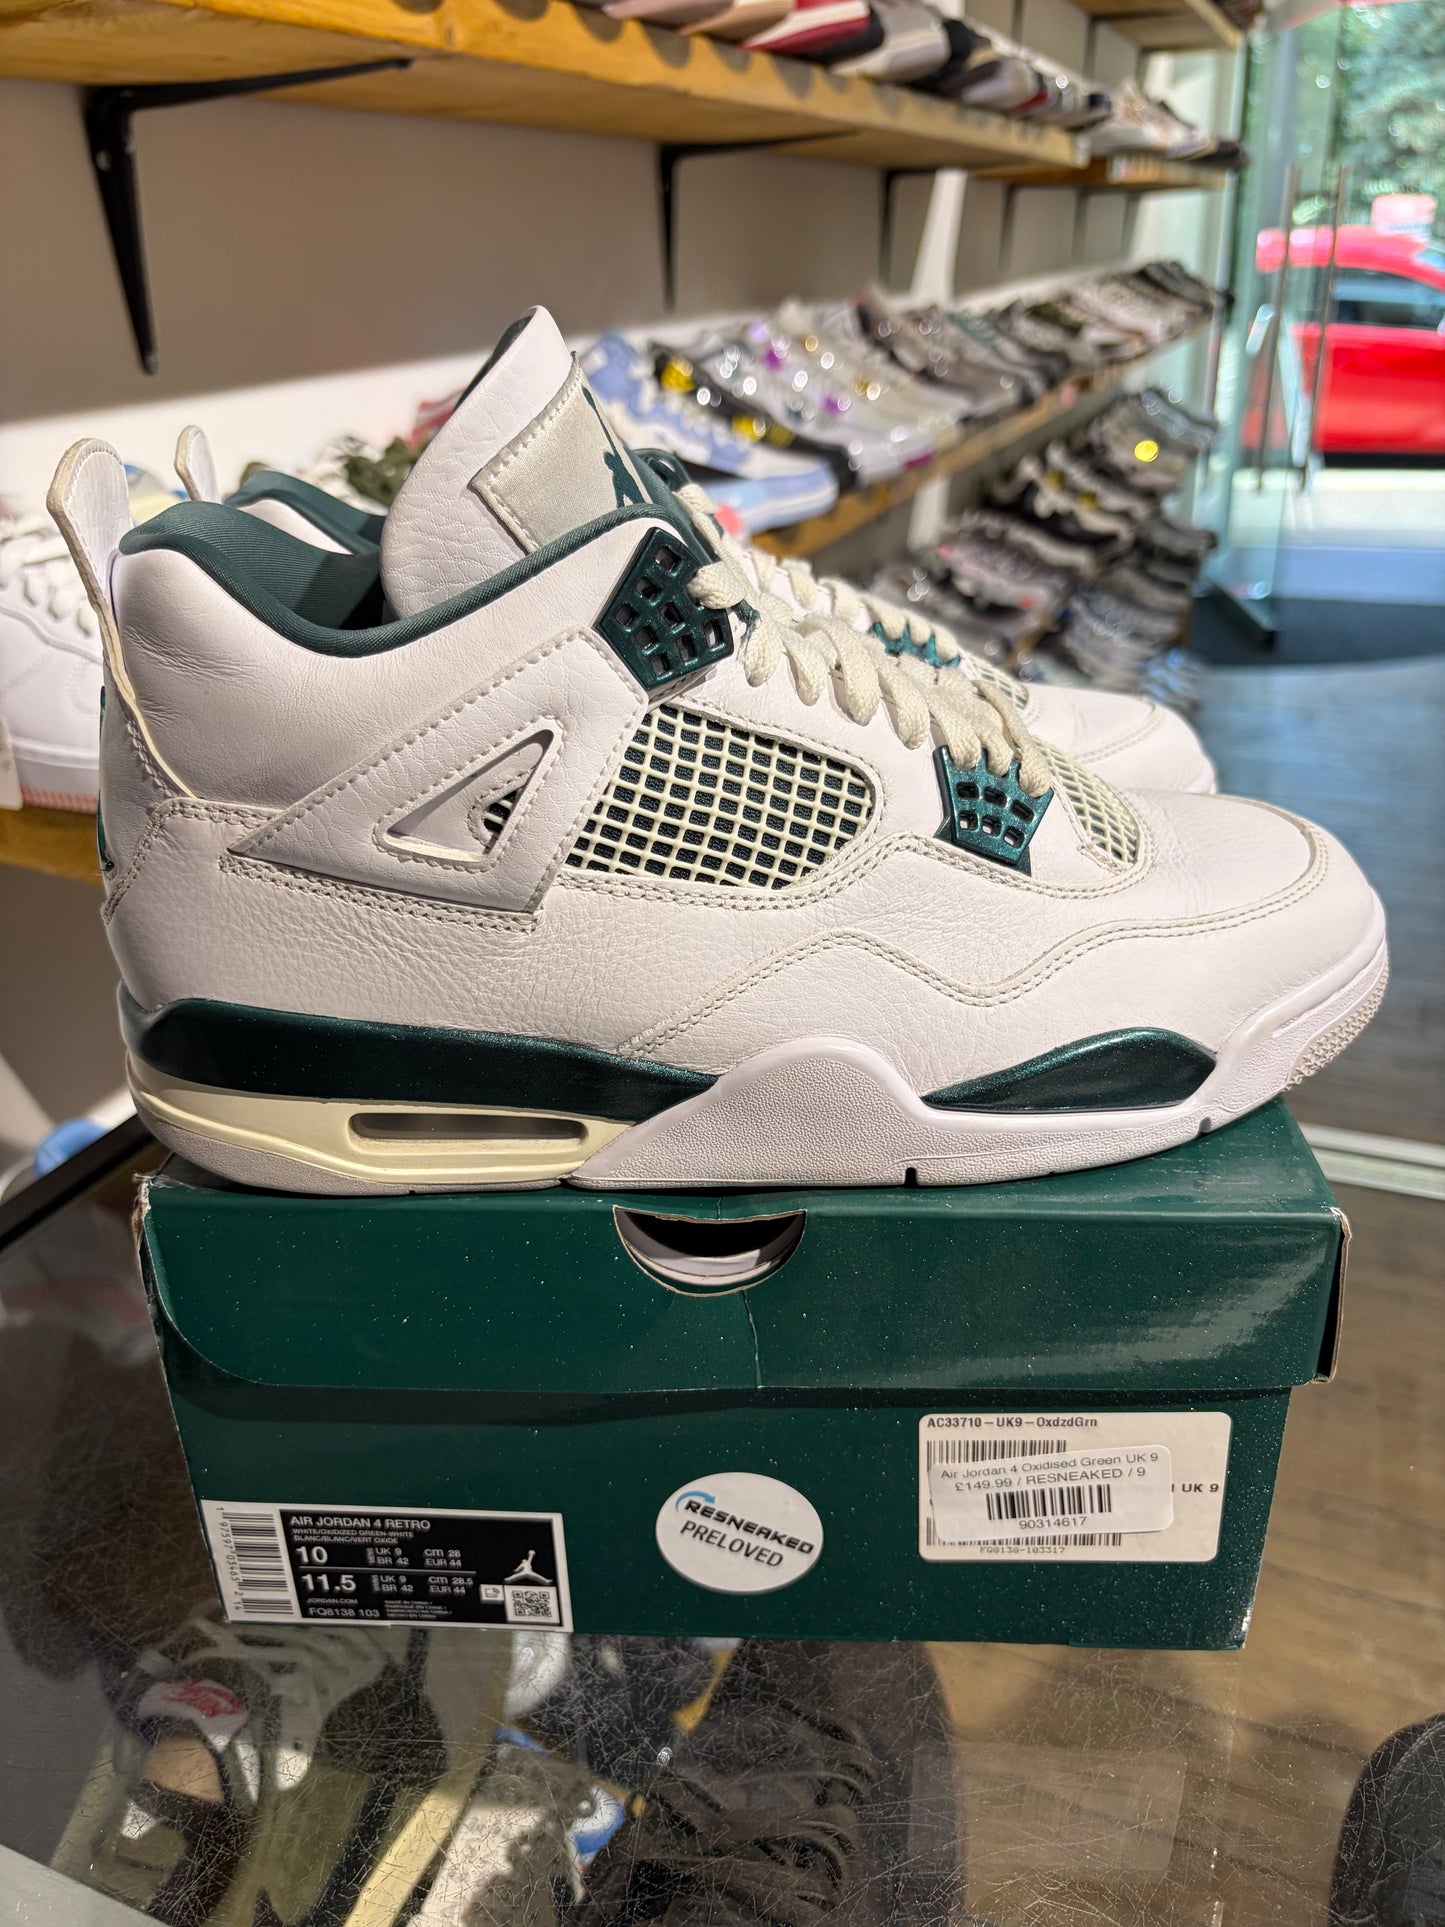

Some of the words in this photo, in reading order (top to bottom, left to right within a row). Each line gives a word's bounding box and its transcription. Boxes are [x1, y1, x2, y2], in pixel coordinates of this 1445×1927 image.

[941, 1470, 957, 1479] Air
[962, 1467, 1006, 1479] Jordan
[1010, 1465, 1017, 1473] 4
[1021, 1459, 1077, 1473] Oxidised
[1080, 1455, 1121, 1467] Green
[1126, 1453, 1146, 1463] UK
[1150, 1452, 1159, 1462] 9
[954, 1478, 1012, 1492] £149.99
[1025, 1468, 1123, 1486] RESNEAKED
[1136, 1466, 1146, 1477] 9
[1181, 1483, 1204, 1493] UK
[1209, 1483, 1219, 1493] 9
[290, 1516, 314, 1526] AIR
[316, 1517, 371, 1528] JORDAN
[373, 1519, 382, 1527] 4
[385, 1519, 431, 1530] RETRO
[684, 1499, 815, 1555] RESNEAKED
[1019, 1517, 1087, 1530] 90314617
[680, 1520, 784, 1567] PRELOVED
[296, 1546, 328, 1564] 10
[375, 1547, 391, 1556] UK
[394, 1548, 402, 1556] 9
[448, 1550, 461, 1558] 28
[377, 1557, 393, 1565] BR
[396, 1557, 410, 1566] 42
[426, 1559, 447, 1567] EUR
[448, 1560, 462, 1568] 44
[302, 1574, 356, 1592] 11.5
[380, 1575, 396, 1583] UK
[399, 1575, 407, 1583] 9
[452, 1577, 474, 1586] 28.5
[382, 1584, 397, 1593] BR
[401, 1585, 414, 1593] 42
[430, 1586, 451, 1594] EUR
[453, 1587, 466, 1595] 44
[309, 1608, 355, 1617] FQ8138
[359, 1609, 380, 1618] 103
